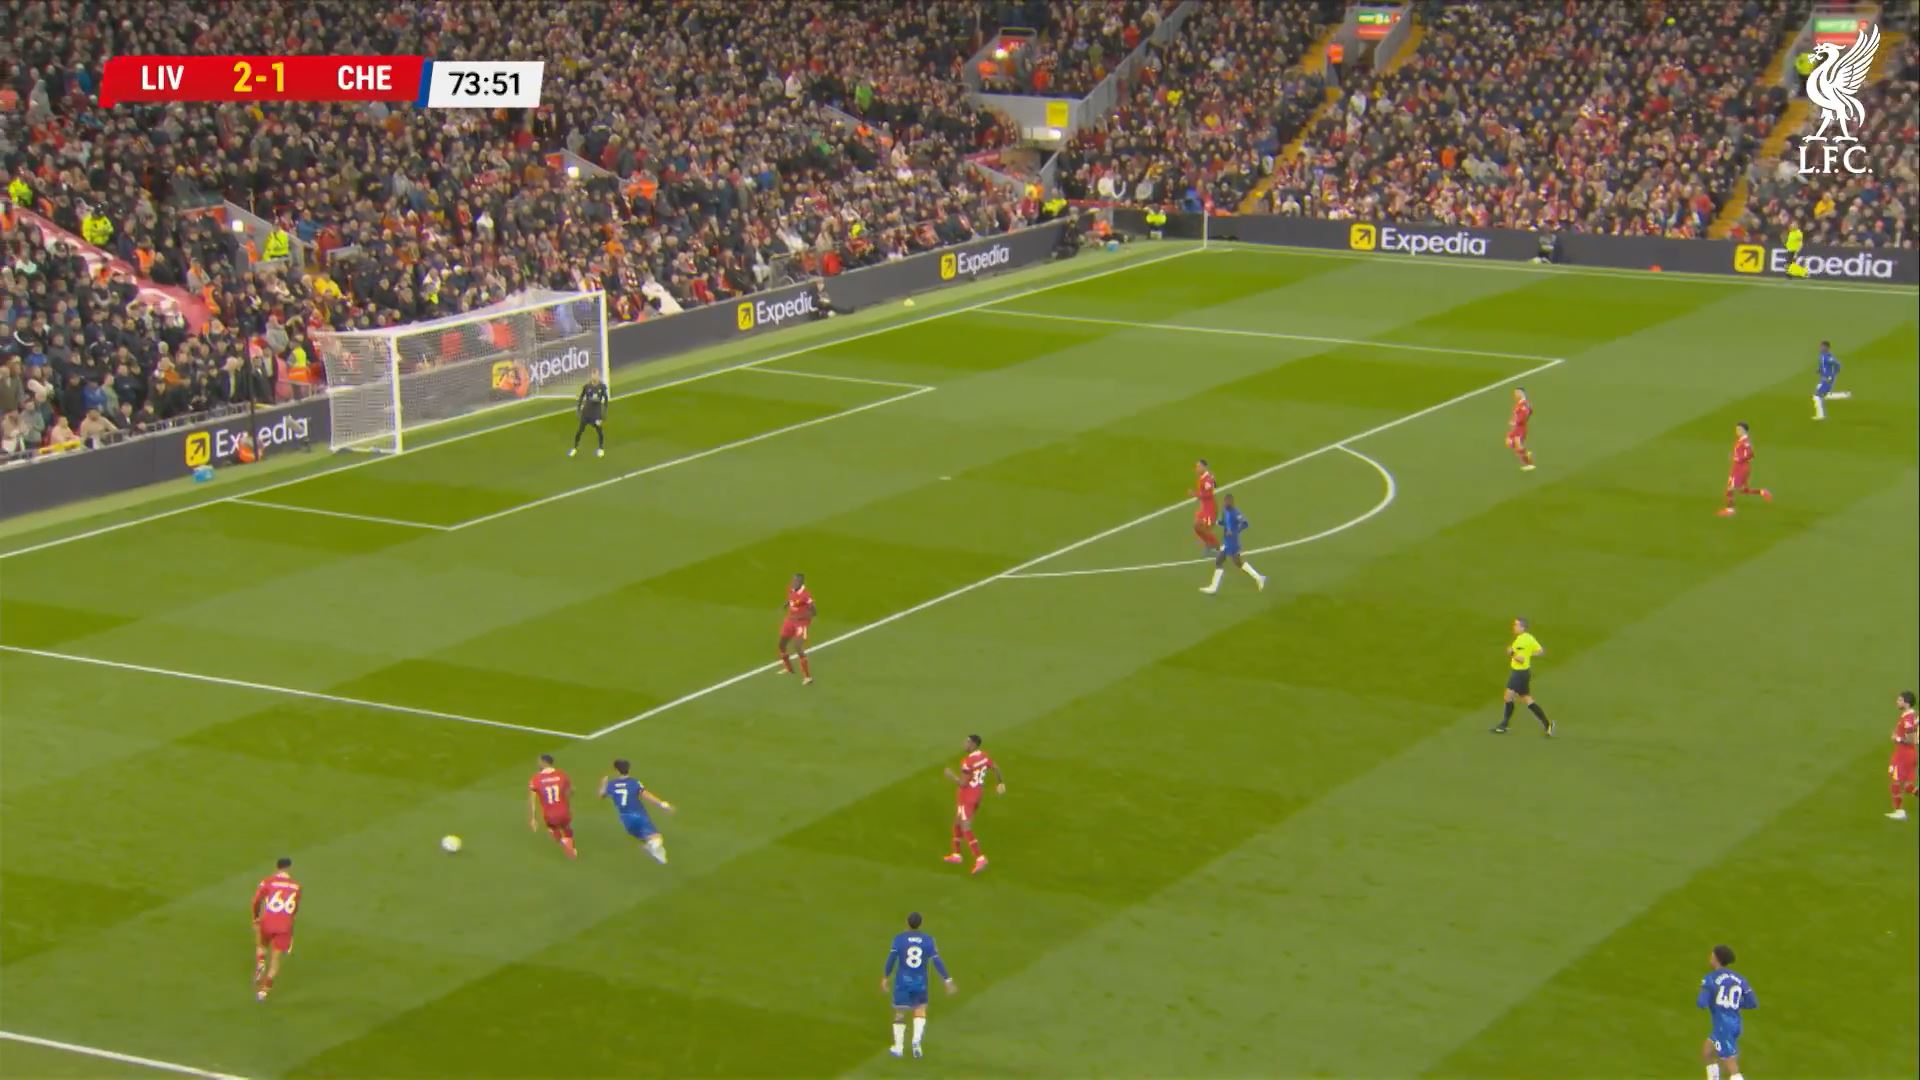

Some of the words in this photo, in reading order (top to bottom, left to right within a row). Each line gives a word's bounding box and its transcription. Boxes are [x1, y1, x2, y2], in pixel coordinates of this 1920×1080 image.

[1381, 227, 1487, 256] Expedia
[958, 243, 1010, 275] Expedia
[529, 346, 590, 387] xpedia
[215, 414, 308, 458] Exedia
[545, 784, 560, 804] 11
[614, 788, 628, 806] 7
[268, 889, 297, 914] 66
[905, 945, 923, 969] 8
[1715, 985, 1742, 1010] 40
